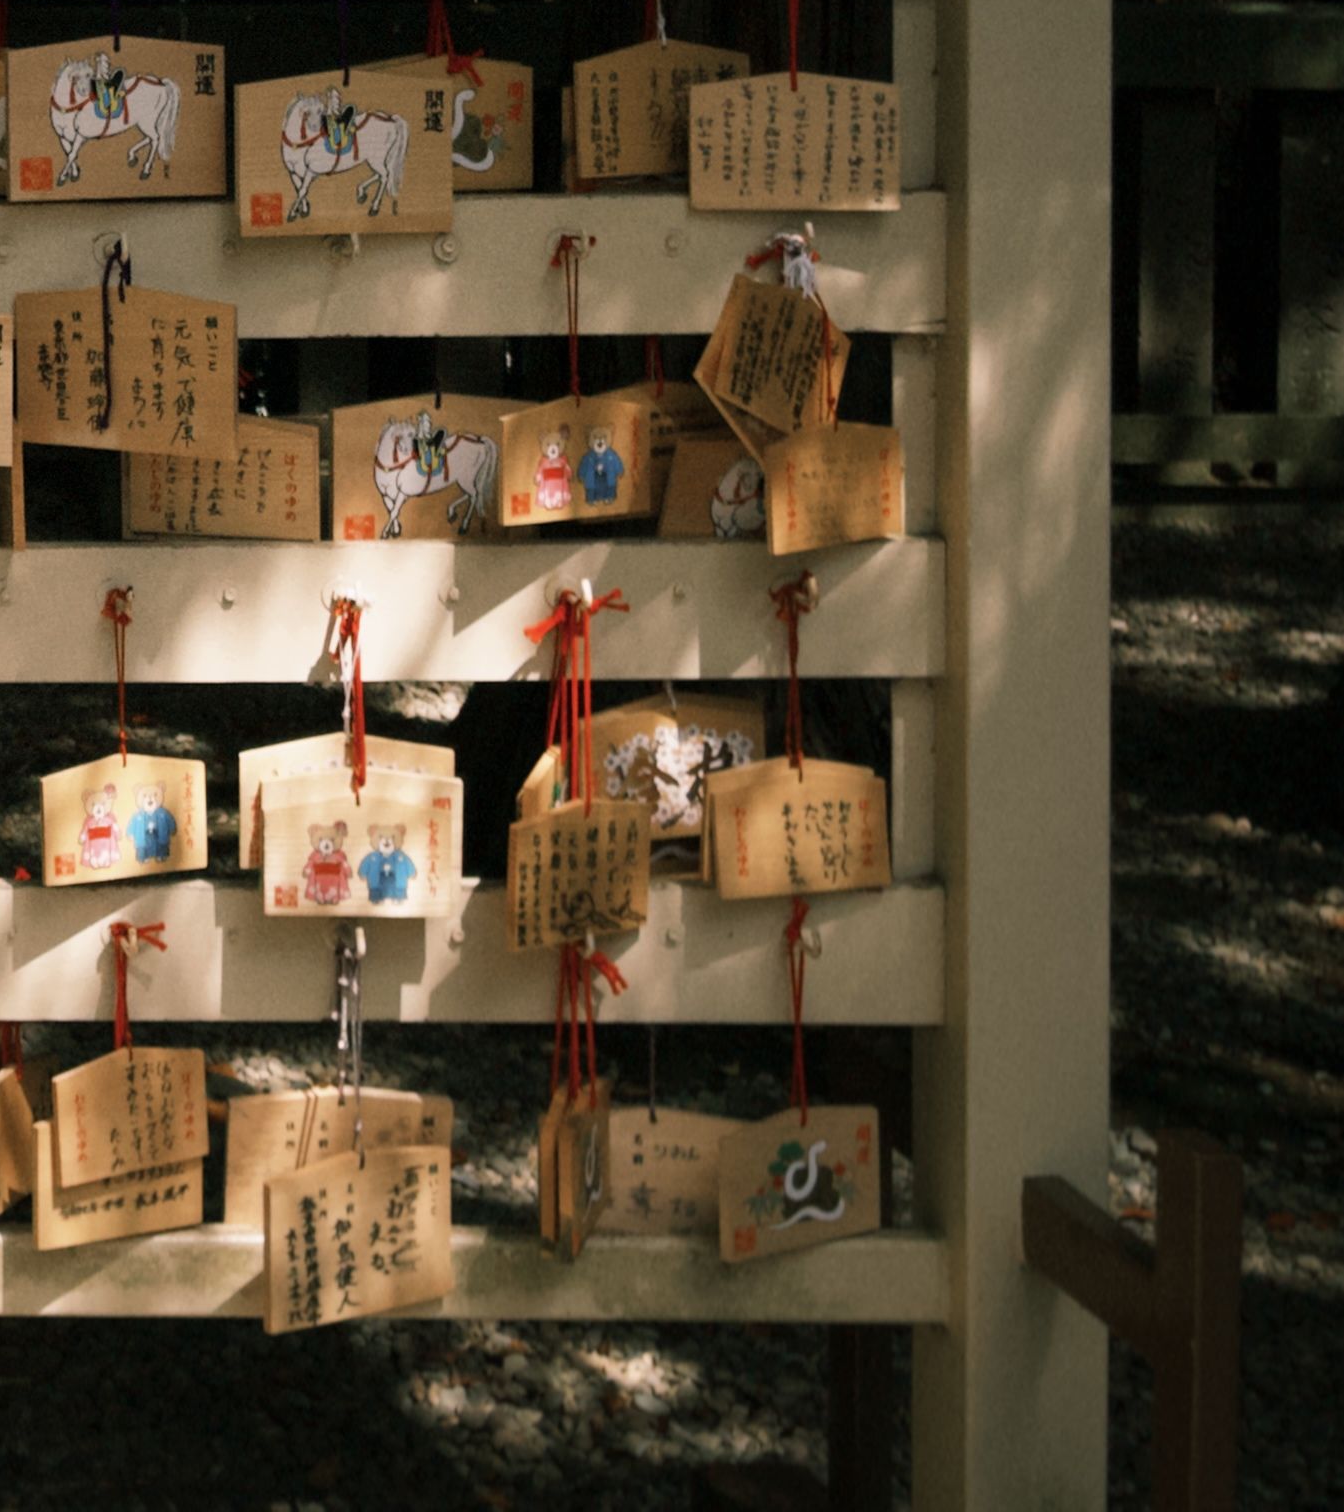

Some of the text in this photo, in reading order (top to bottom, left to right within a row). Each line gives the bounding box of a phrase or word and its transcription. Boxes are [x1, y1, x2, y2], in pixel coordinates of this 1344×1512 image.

[194, 53, 216, 96] 開運
[424, 89, 445, 133] 開運
[205, 315, 219, 371] 願いごと
